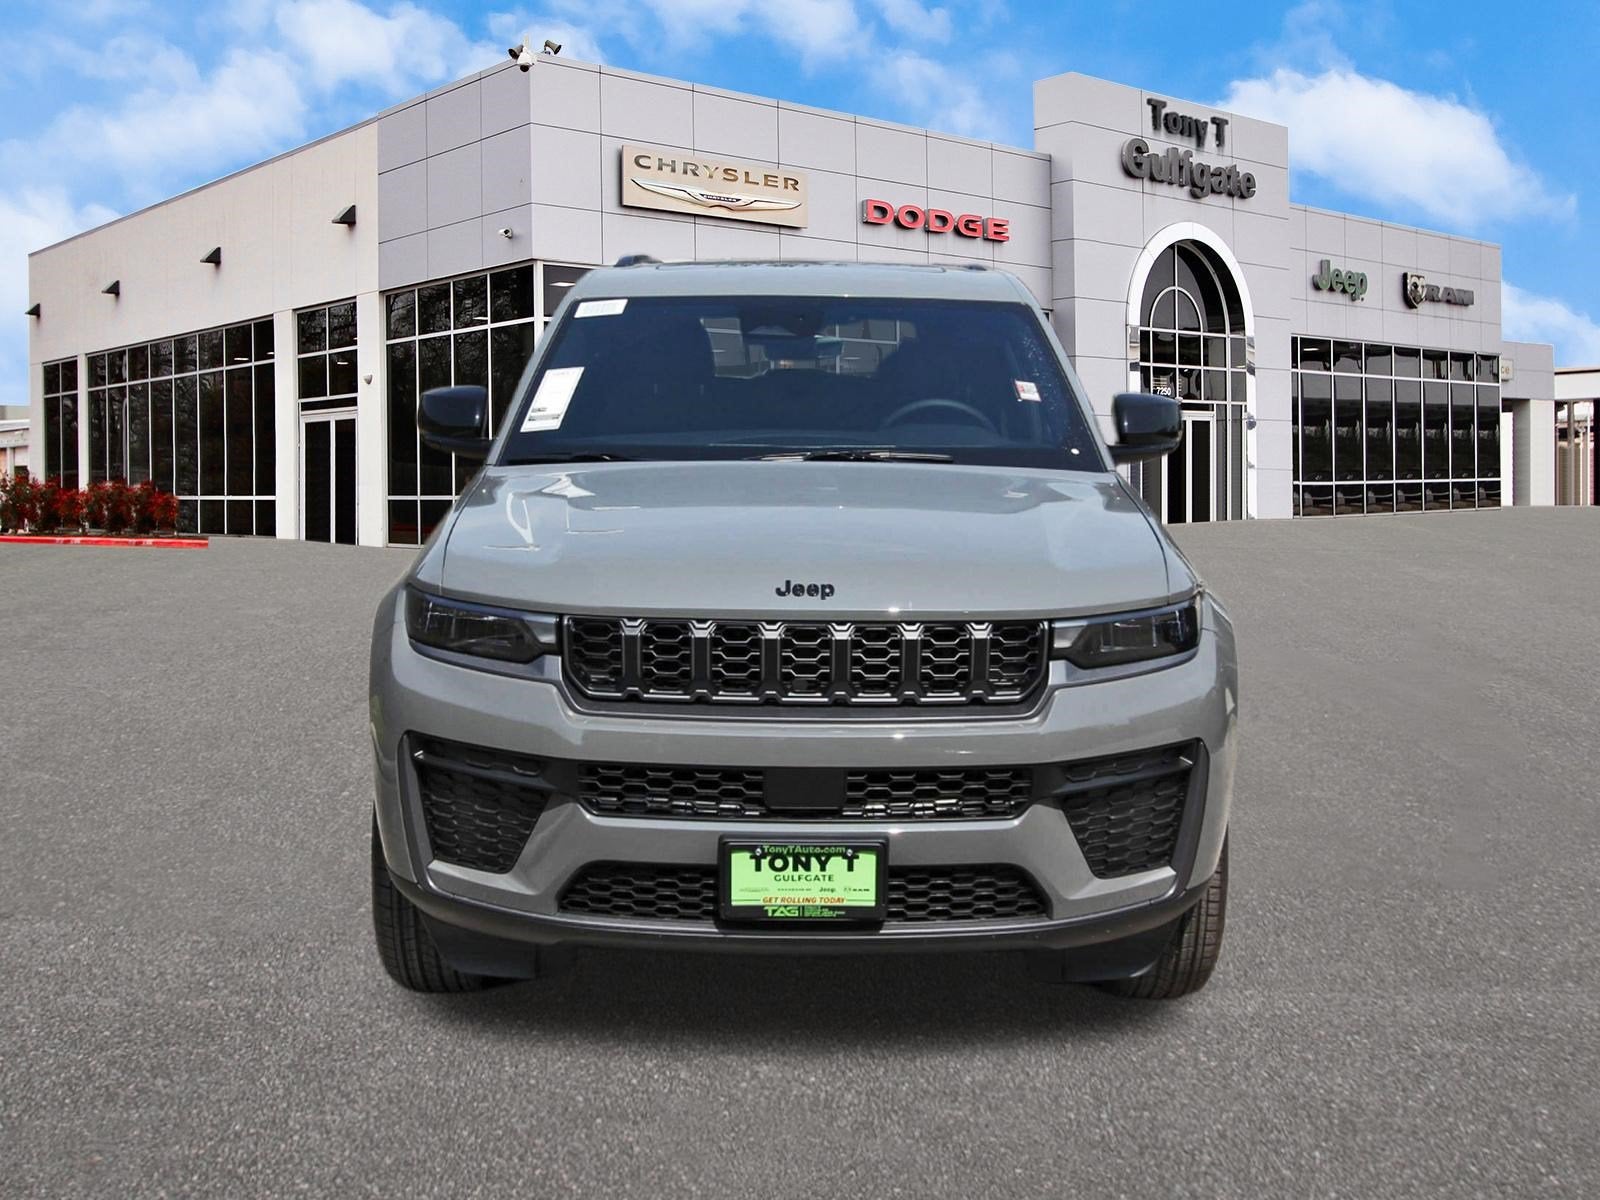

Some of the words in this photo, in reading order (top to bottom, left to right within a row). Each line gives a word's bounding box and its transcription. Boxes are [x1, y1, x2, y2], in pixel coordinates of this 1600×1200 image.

[1147, 98, 1208, 147] Tony
[1211, 117, 1228, 147] T
[633, 154, 801, 192] CHRYSLER
[1121, 137, 1257, 199] Gulfgate
[862, 198, 1011, 242] DODGE
[1312, 259, 1368, 302] Jeep
[1424, 283, 1475, 307] RAM
[775, 579, 835, 601] Jeep
[763, 845, 846, 854] TonyTAuto.com
[750, 854, 830, 872] TONY
[842, 854, 860, 872] T
[774, 874, 835, 882] GULFGATE
[762, 896, 780, 904] GET
[781, 896, 818, 904] ROLLING
[819, 896, 846, 904] TODAY
[763, 906, 799, 917] TAG
